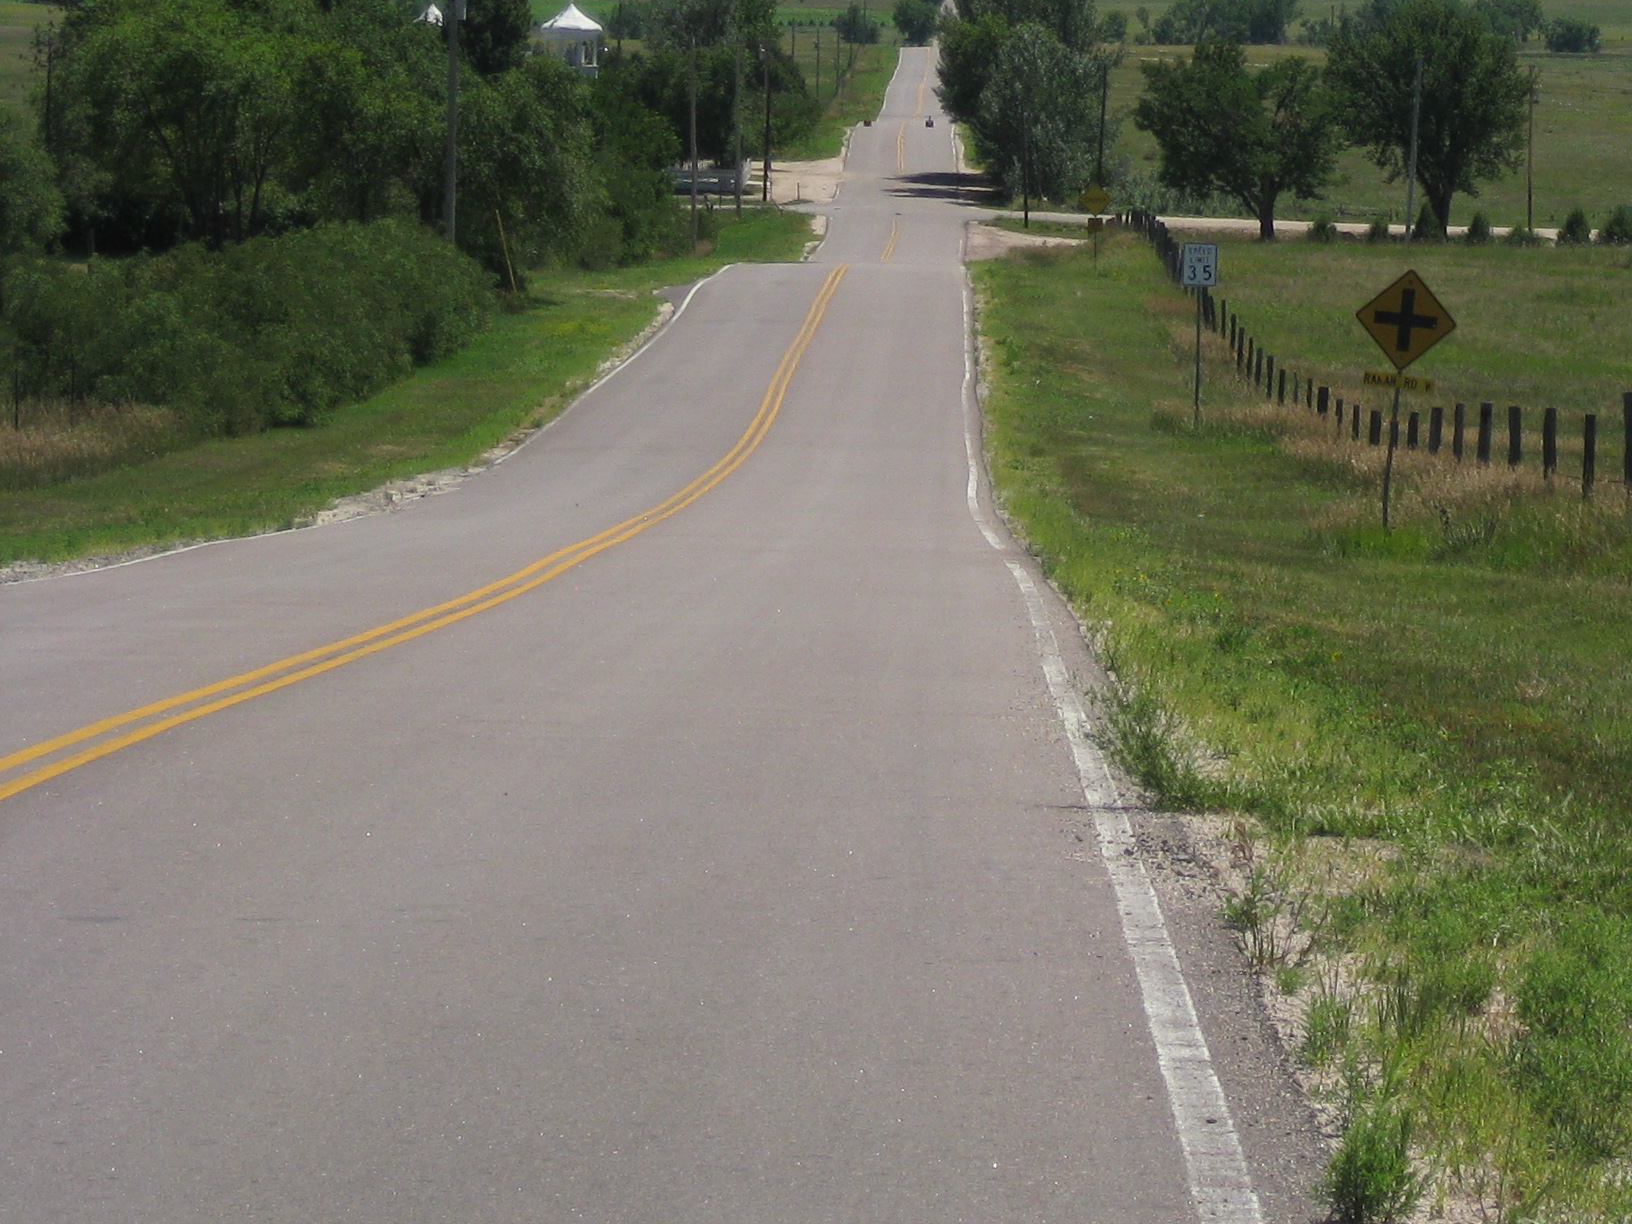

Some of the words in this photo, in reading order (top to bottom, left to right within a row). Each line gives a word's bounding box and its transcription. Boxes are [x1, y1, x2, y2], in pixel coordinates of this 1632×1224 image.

[1188, 246, 1211, 255] SPEED
[1187, 264, 1212, 281] 35
[1403, 377, 1417, 390] RD
